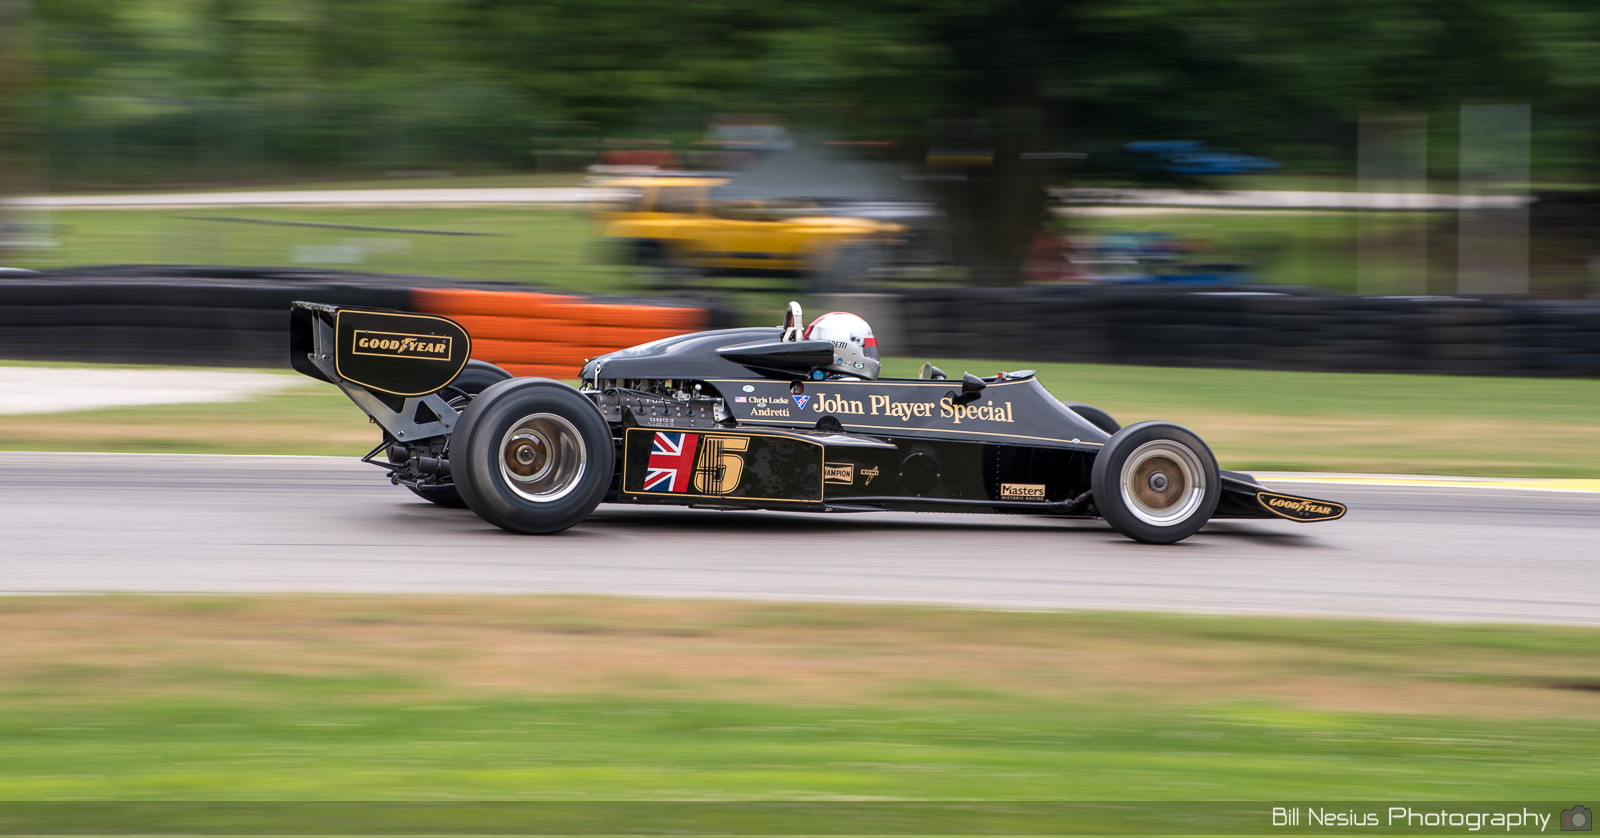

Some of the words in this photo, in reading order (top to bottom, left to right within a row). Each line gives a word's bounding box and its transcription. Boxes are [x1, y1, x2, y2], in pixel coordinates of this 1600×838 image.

[358, 337, 446, 353] GOODYEAR
[748, 396, 768, 404] Chris
[769, 396, 789, 404] Locke
[750, 407, 790, 417] Andretti
[812, 392, 865, 415] John
[869, 394, 936, 421] Player
[939, 397, 1014, 424] Special
[693, 434, 751, 495] 5
[824, 469, 850, 478] AMPION
[1002, 485, 1044, 496] Masters
[1269, 498, 1332, 515] GOODYEAR
